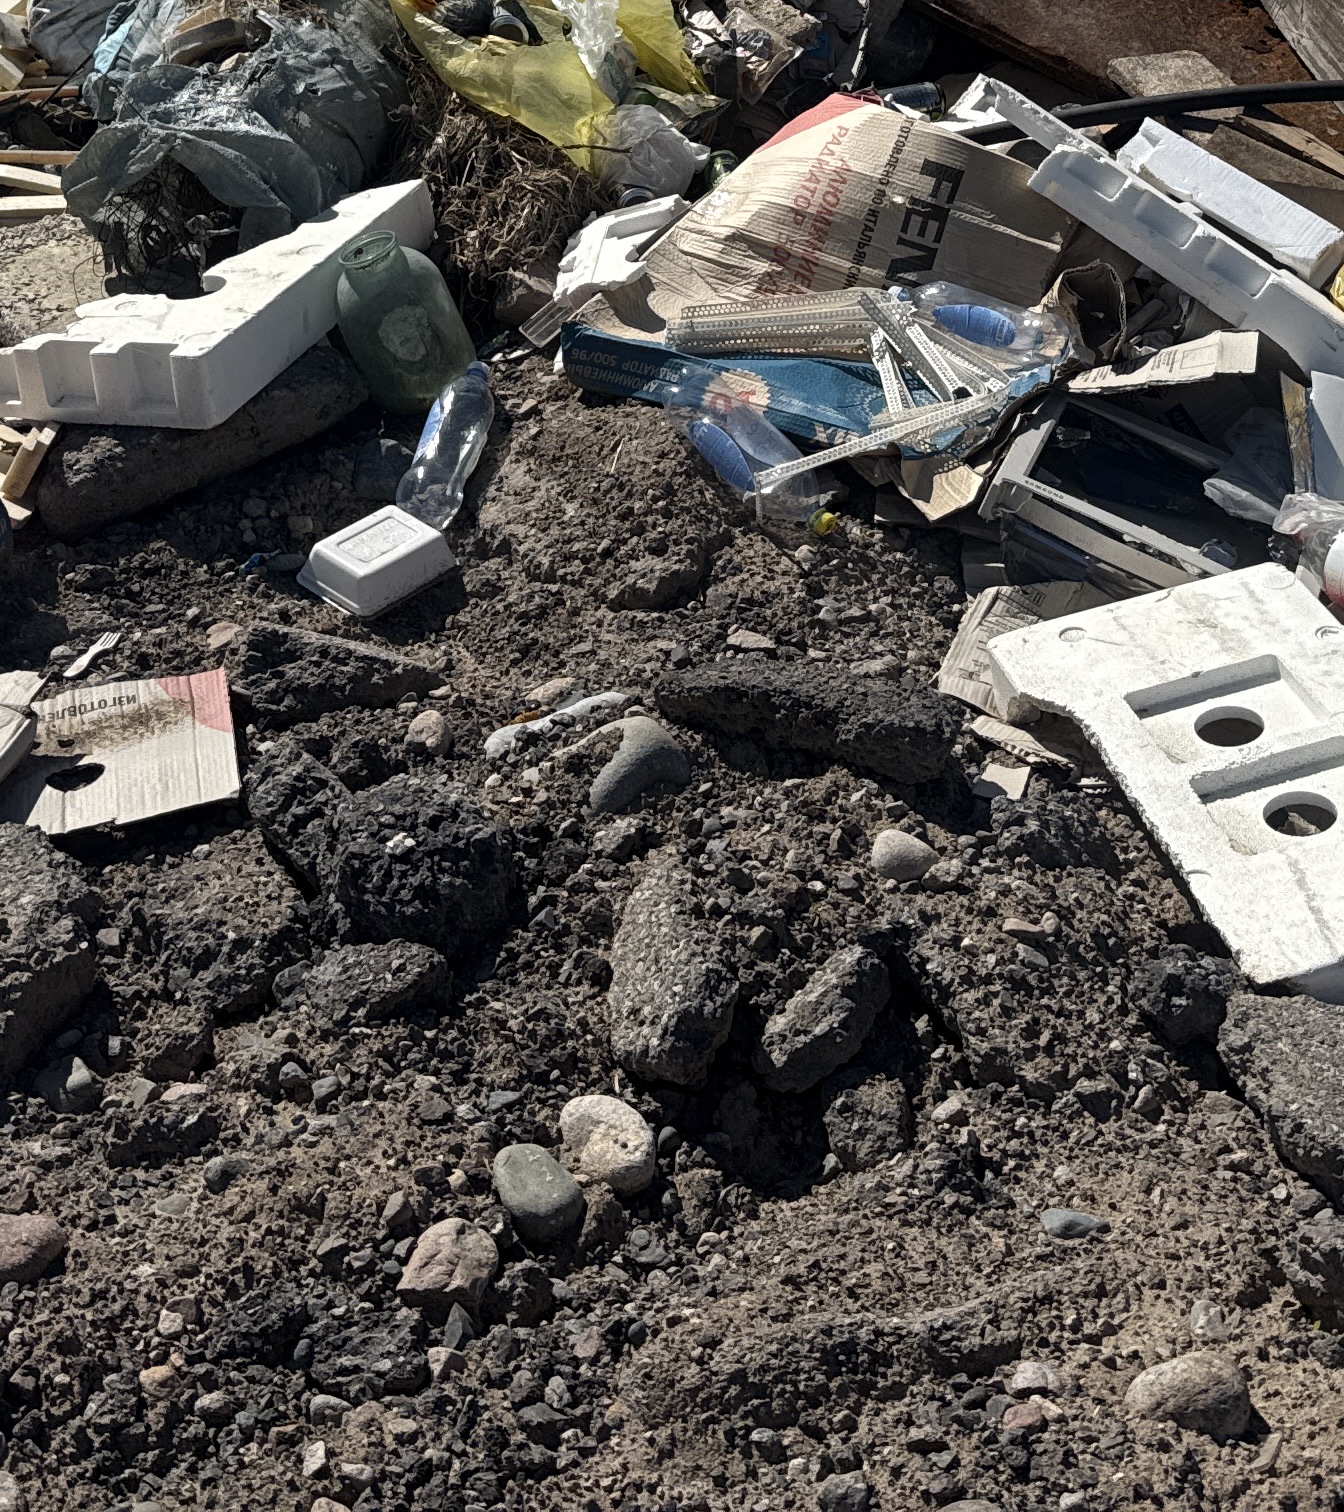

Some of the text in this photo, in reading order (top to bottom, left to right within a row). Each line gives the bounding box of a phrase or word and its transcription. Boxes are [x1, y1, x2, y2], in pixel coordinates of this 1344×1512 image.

[872, 187, 885, 205] ПО
[880, 157, 966, 289] FEN
[843, 208, 881, 289] ИТАЛЬЯНСКИ
[571, 348, 681, 383] РАДИАТОР 500/96
